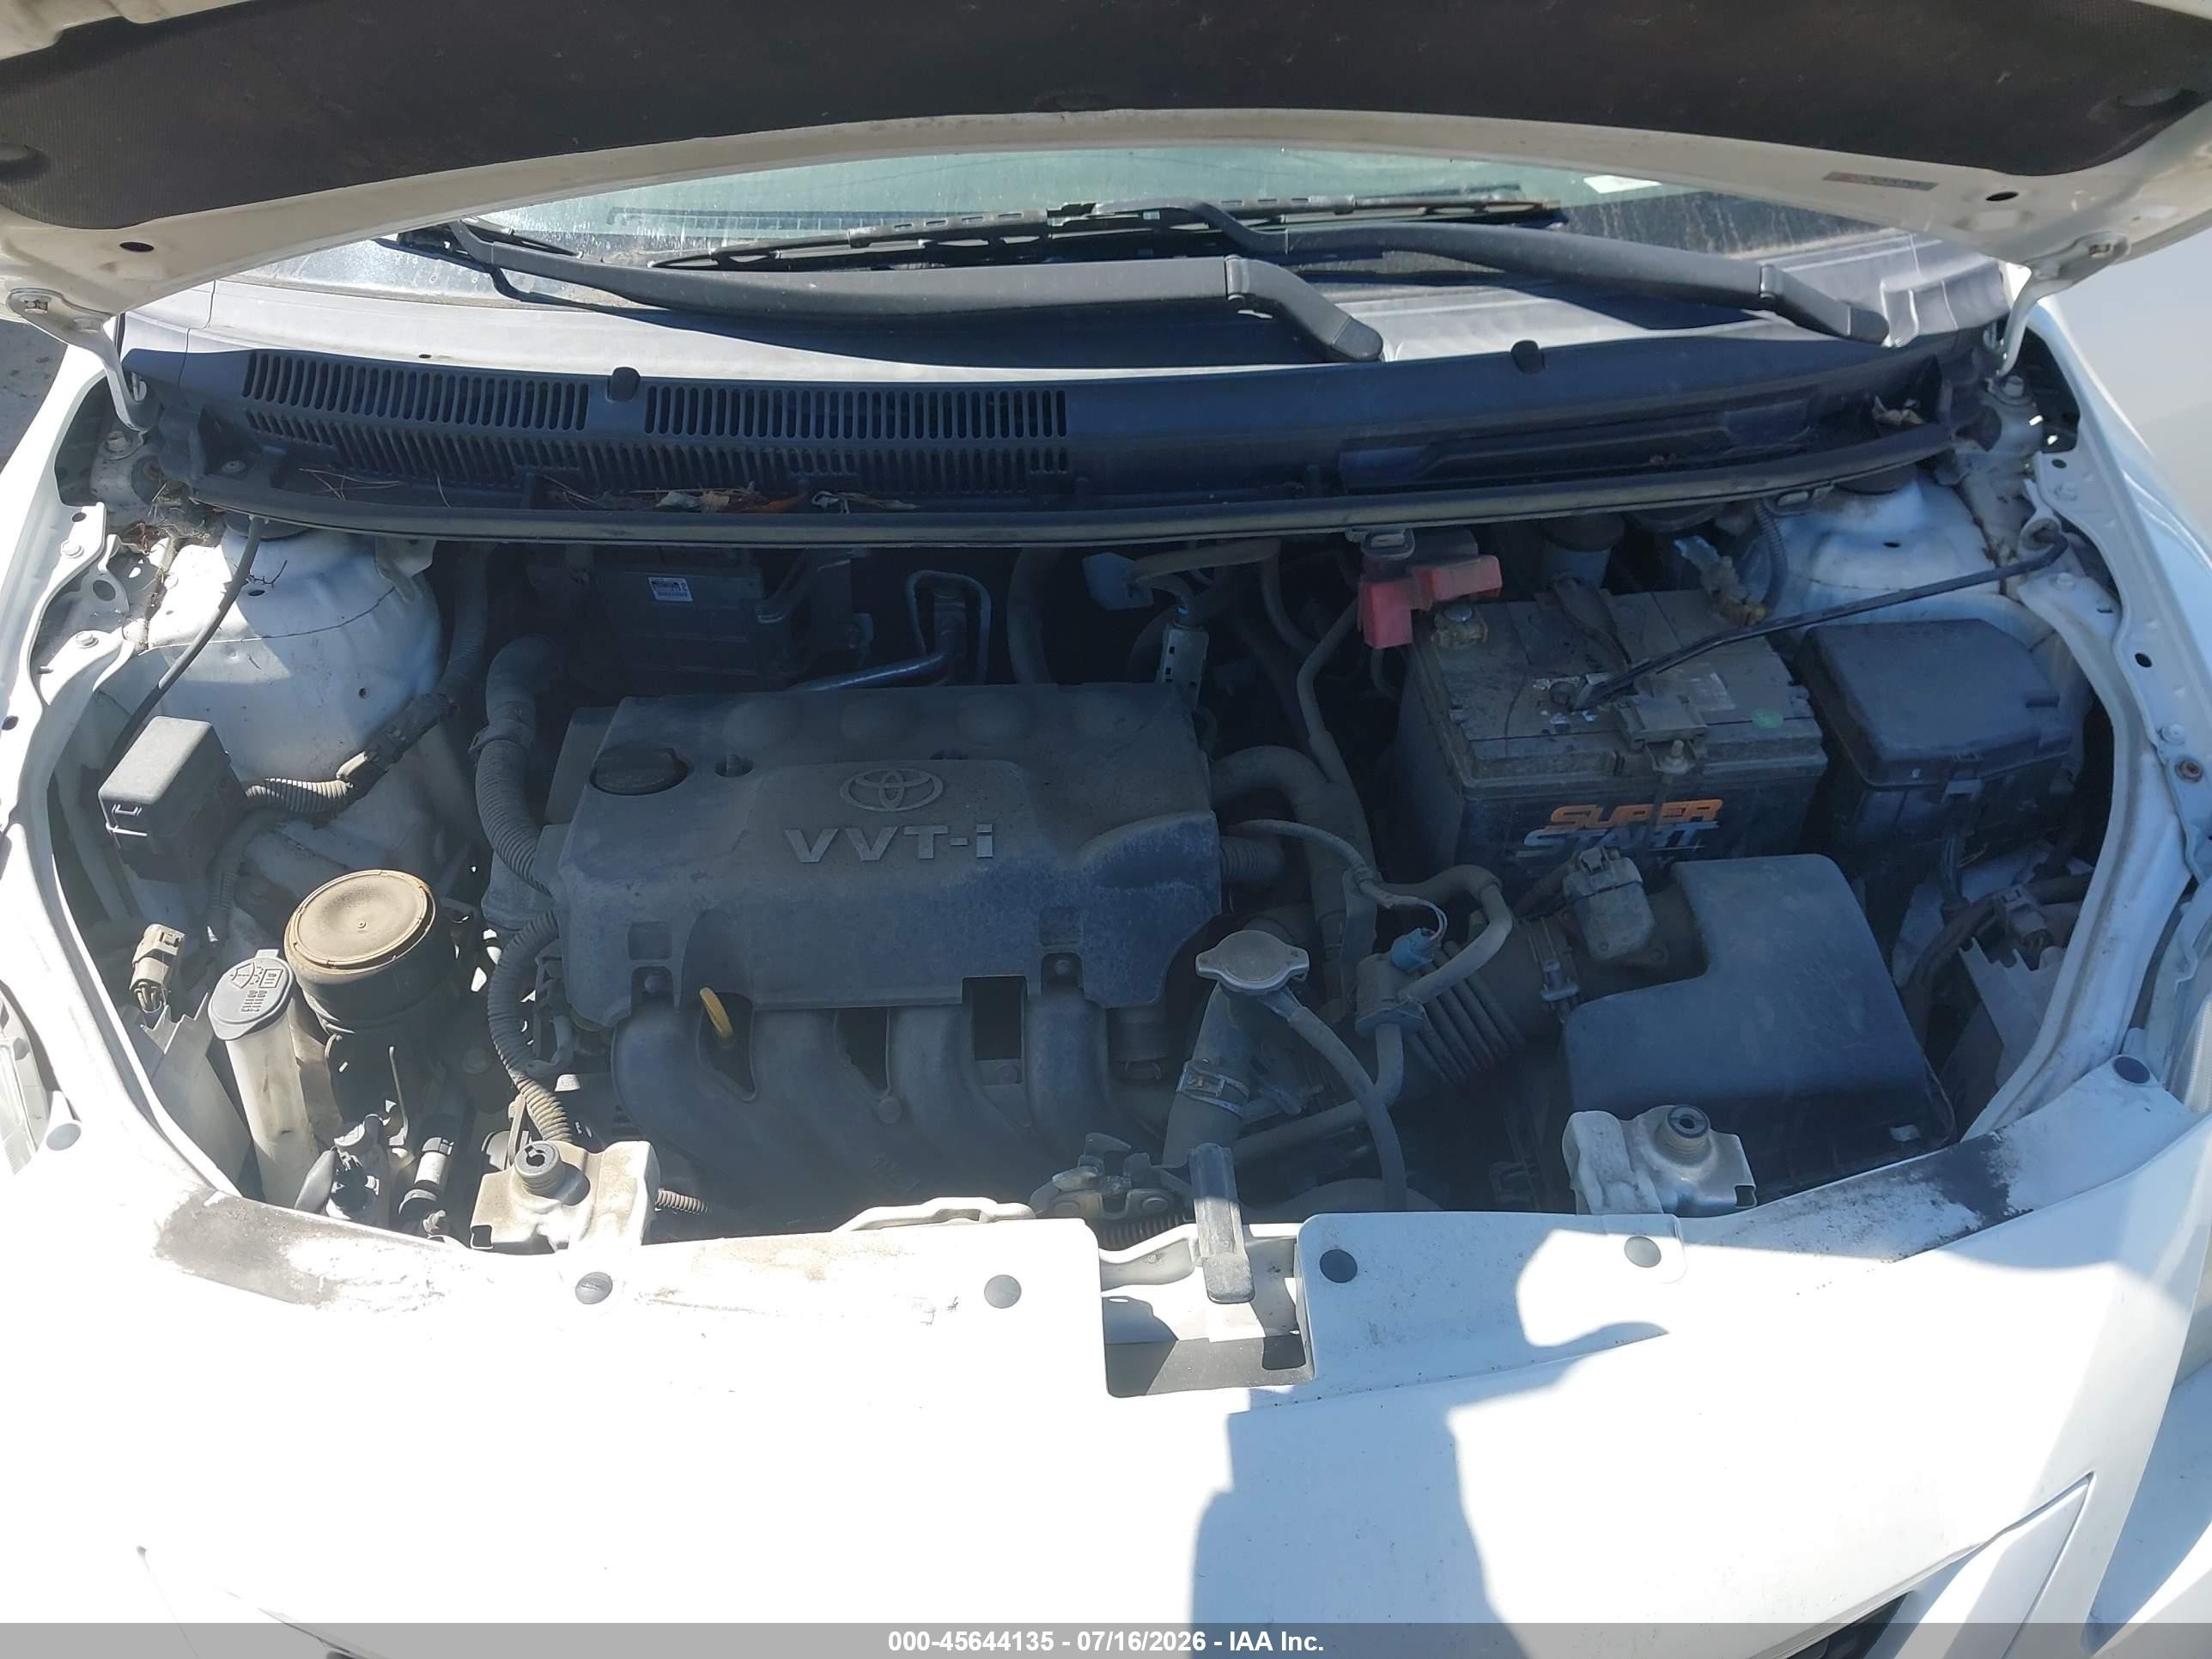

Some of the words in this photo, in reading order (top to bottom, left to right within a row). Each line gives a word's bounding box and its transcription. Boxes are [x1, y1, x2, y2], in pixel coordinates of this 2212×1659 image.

[1544, 799, 1723, 832] SUPER
[782, 823, 994, 863] VVT-i
[1515, 821, 1721, 859] START
